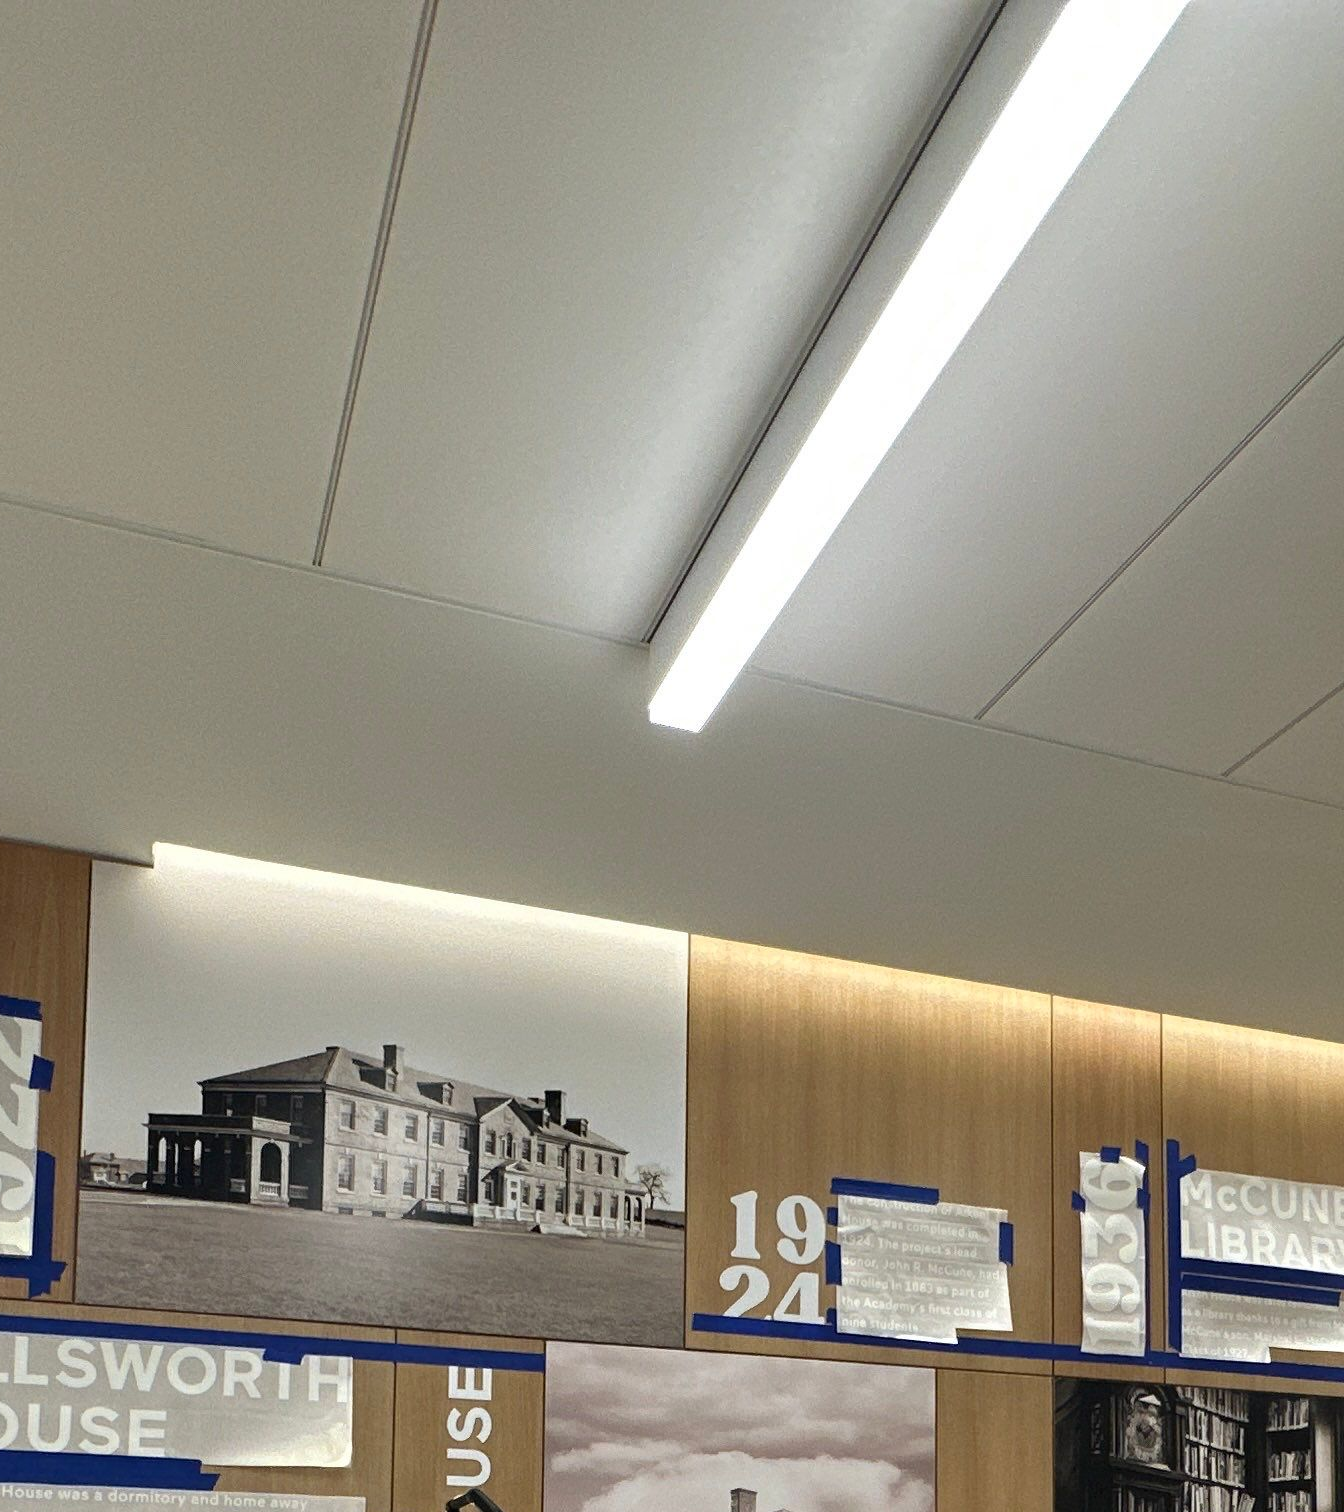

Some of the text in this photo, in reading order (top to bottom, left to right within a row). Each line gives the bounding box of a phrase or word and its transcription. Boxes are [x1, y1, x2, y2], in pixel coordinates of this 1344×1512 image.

[730, 1190, 826, 1265] 19
[1084, 1157, 1142, 1346] 1936
[719, 1264, 825, 1325] 24
[2, 1485, 52, 1500] House
[57, 1490, 89, 1501] was
[94, 1492, 103, 1501] a
[107, 1488, 185, 1507] dormitory
[191, 1491, 219, 1506] and
[224, 1493, 266, 1508] home
[270, 1499, 307, 1511] away
